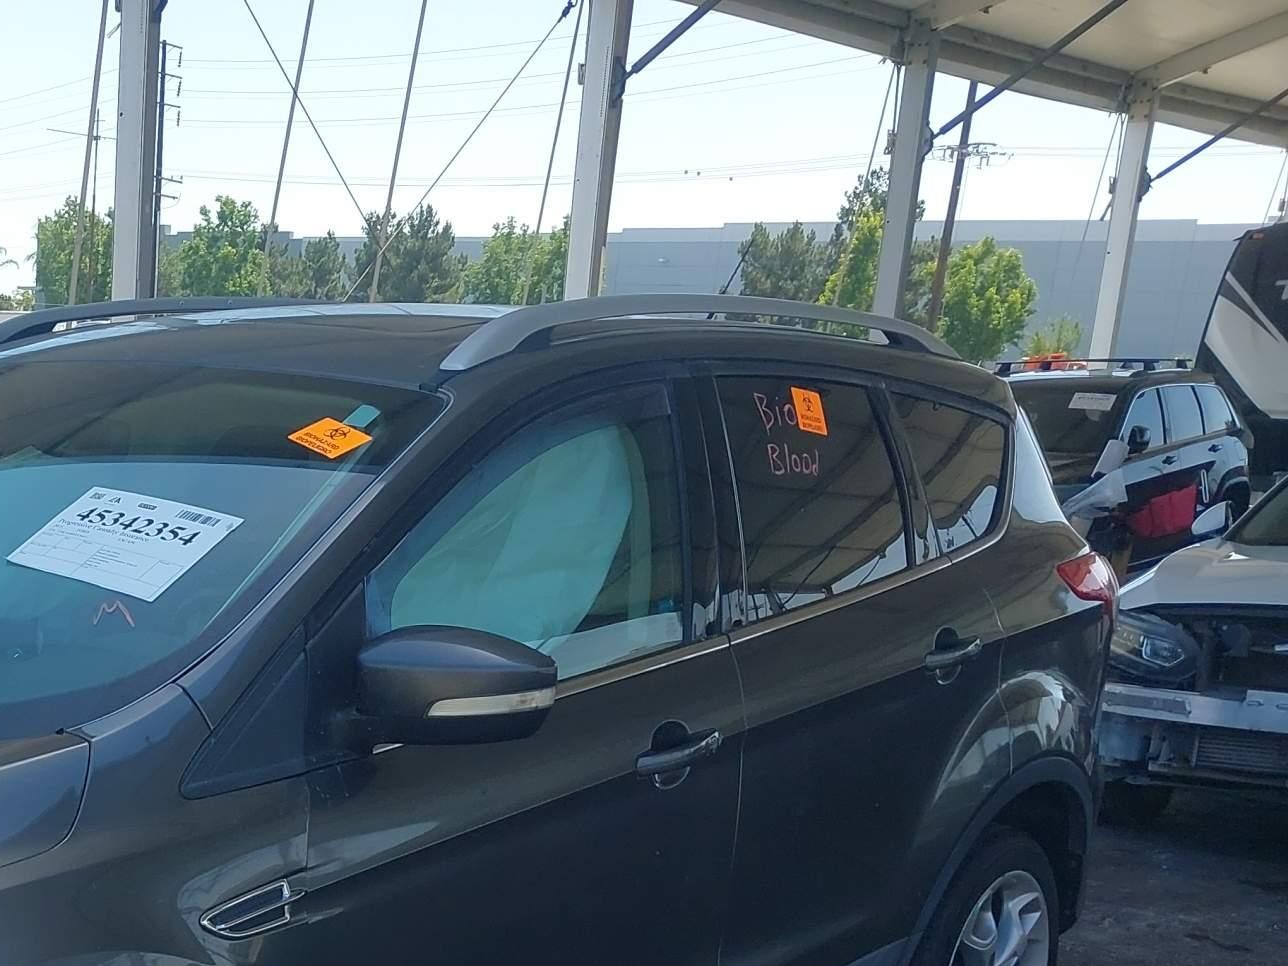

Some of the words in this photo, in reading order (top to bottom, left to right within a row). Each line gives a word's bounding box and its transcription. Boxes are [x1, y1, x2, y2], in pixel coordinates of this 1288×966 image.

[753, 392, 797, 436] Bio
[767, 443, 819, 476] Blood
[76, 507, 201, 546] 45342354
[93, 600, 135, 628] M
